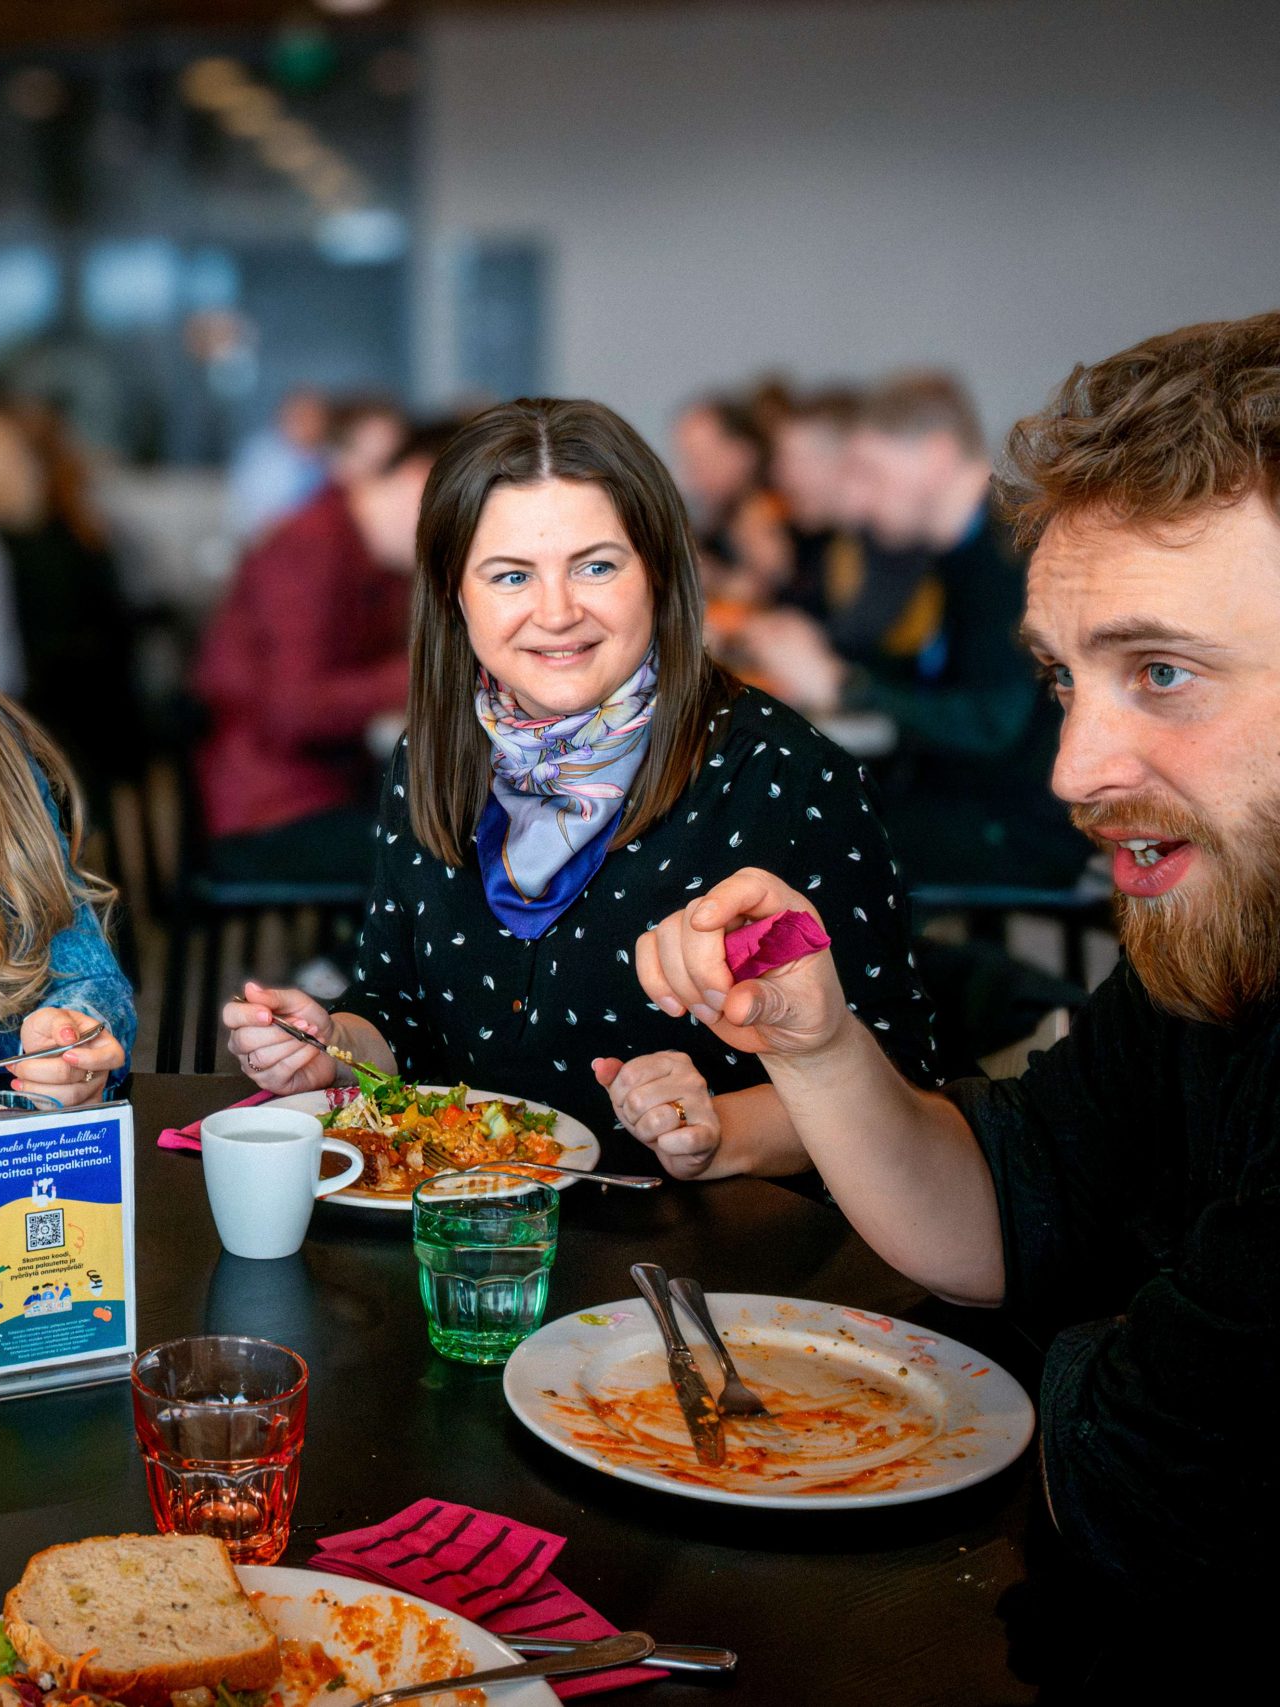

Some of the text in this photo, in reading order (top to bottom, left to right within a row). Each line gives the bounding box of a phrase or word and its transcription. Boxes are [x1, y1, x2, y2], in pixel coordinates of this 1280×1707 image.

[26, 1138, 57, 1151] hymyn
[60, 1127, 107, 1144] huulillesi?
[12, 1153, 43, 1165] meille
[46, 1146, 102, 1162] palautetta,
[36, 1155, 112, 1176] pikapalkinnon!
[17, 1264, 34, 1272] anna
[35, 1260, 68, 1269] palautetta
[22, 1255, 50, 1263] Skannaa
